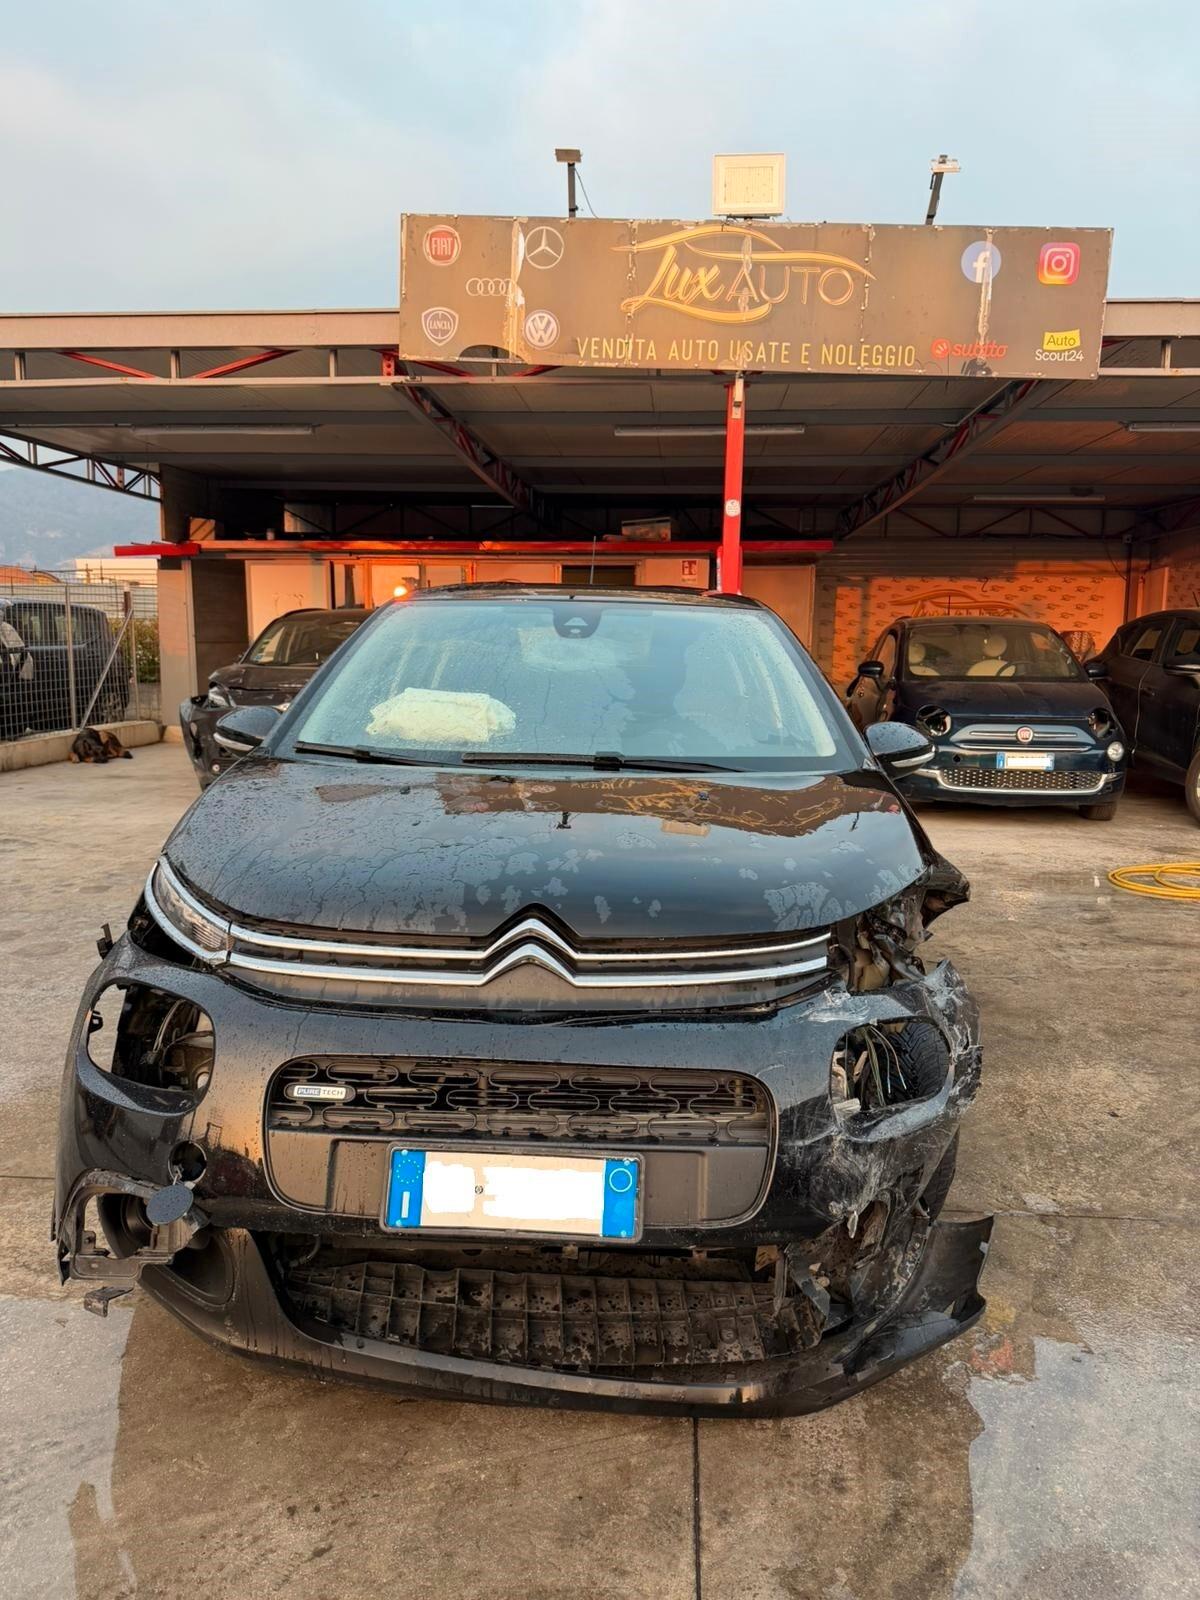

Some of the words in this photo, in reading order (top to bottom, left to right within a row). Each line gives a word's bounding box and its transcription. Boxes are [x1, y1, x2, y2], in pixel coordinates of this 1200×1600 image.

[431, 237, 453, 255] FIAT
[621, 244, 726, 312] Lux
[726, 264, 854, 306] AUTO
[429, 319, 451, 330] LANCIA
[1046, 334, 1076, 347] Auto
[576, 336, 657, 361] VENDITA
[668, 339, 719, 361] AUTO
[729, 340, 791, 364] USATE
[801, 343, 811, 365] E
[821, 343, 916, 367] NOLEGGIO
[1035, 348, 1084, 362] Scout24
[298, 1088, 320, 1096] PURE
